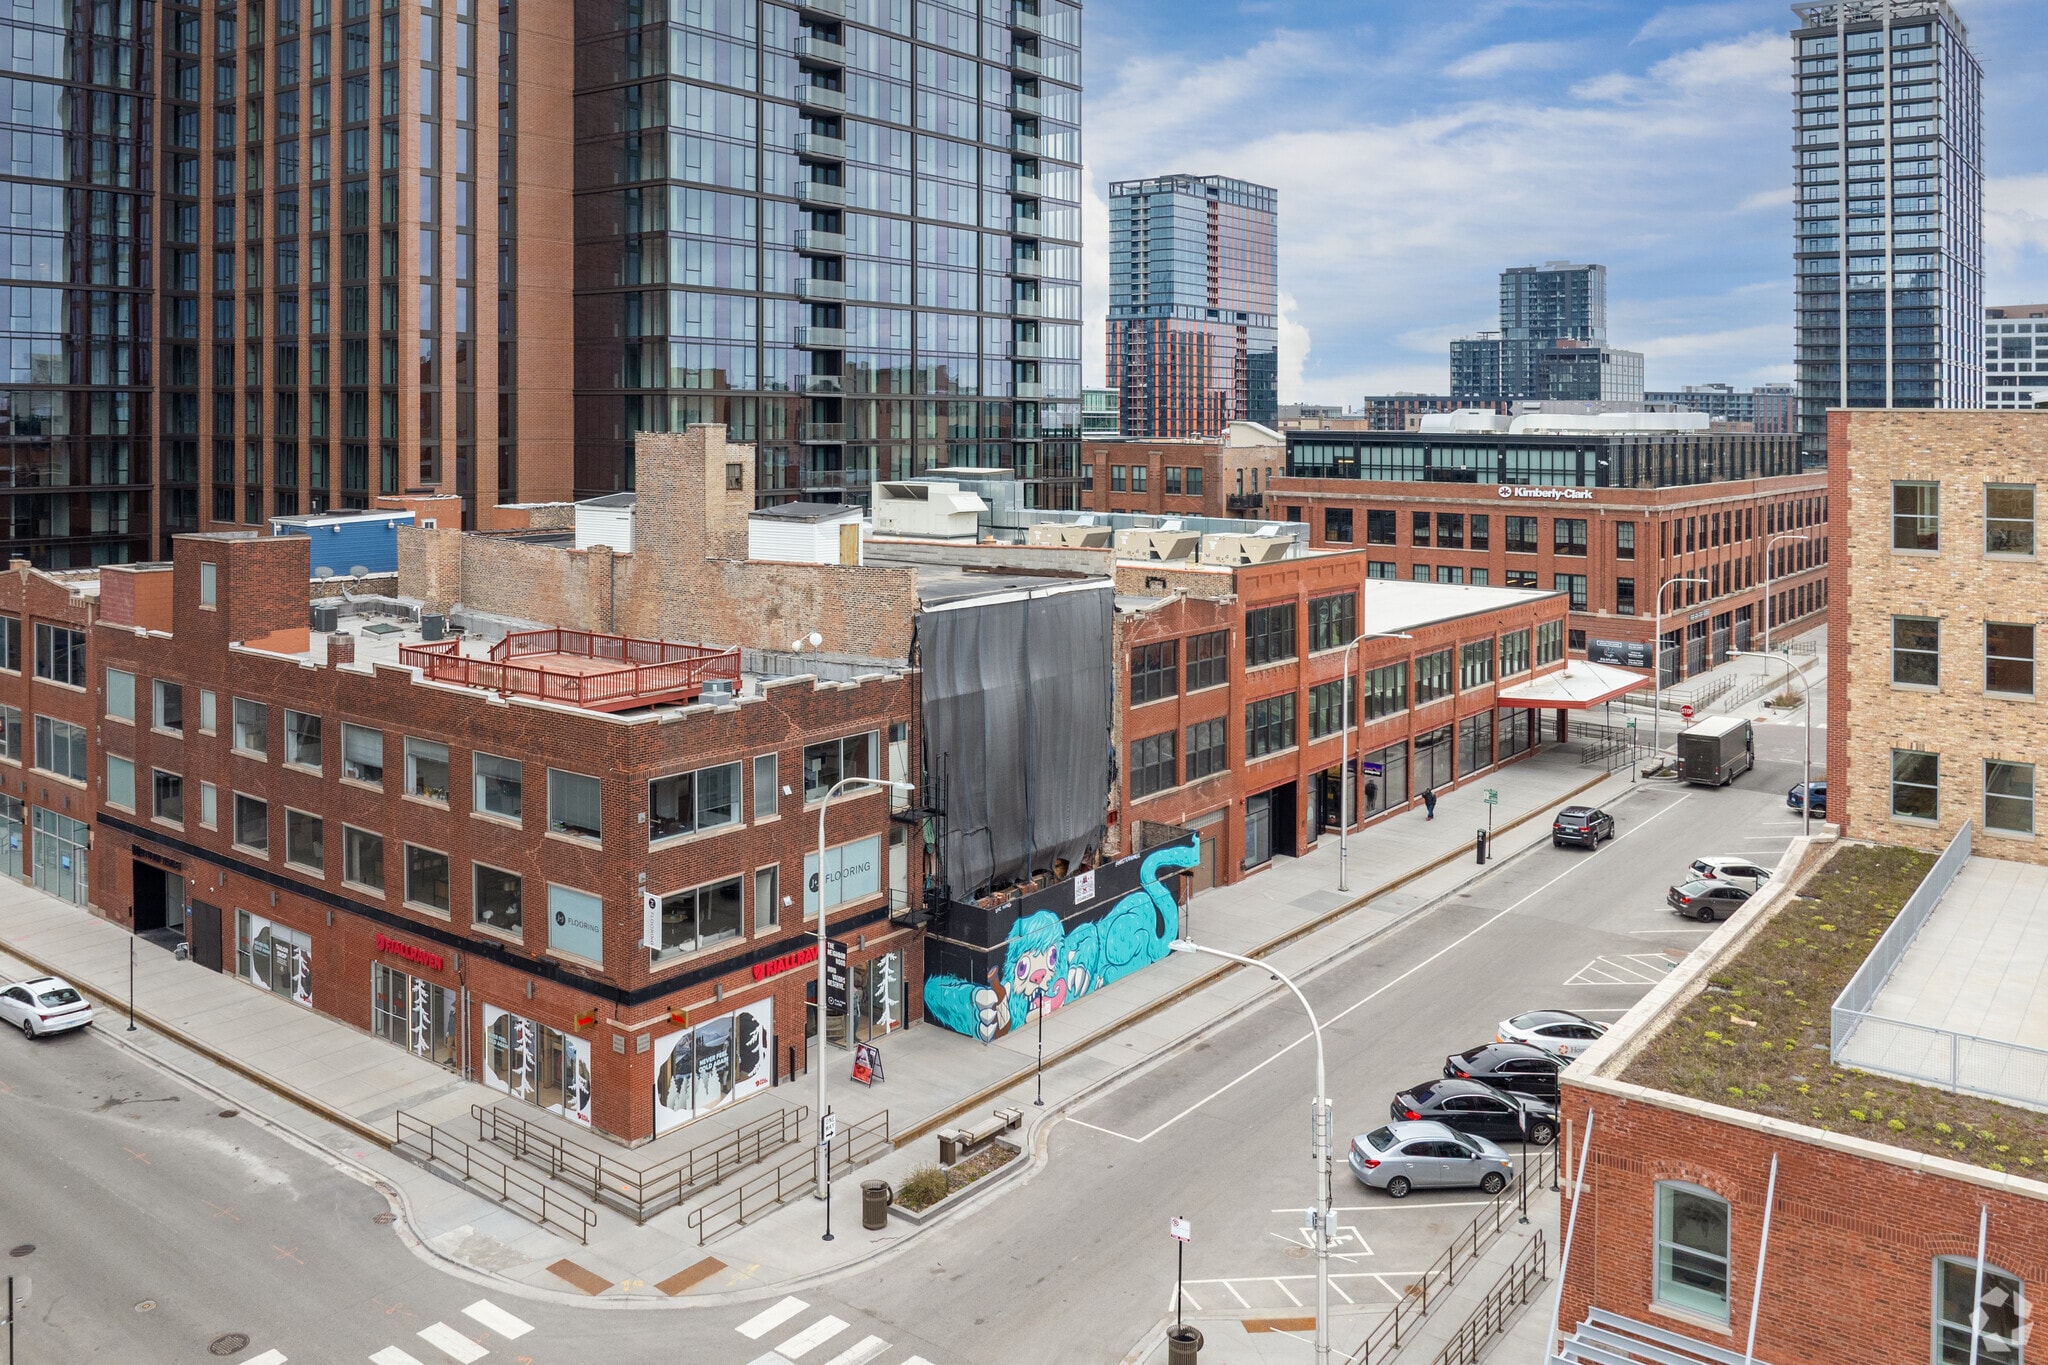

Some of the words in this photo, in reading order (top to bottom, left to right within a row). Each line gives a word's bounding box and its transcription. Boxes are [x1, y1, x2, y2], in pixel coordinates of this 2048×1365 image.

[1514, 487, 1593, 501] Kimberly-Clark
[825, 861, 871, 884] FLOORING
[568, 917, 600, 933] FLOORING
[698, 1062, 713, 1073] COLD
[713, 1056, 729, 1067] AGAIN
[699, 1054, 716, 1066] NEVER
[716, 1050, 728, 1060] FEEL
[825, 1123, 835, 1132] WAY
[826, 1115, 835, 1125] ONE
